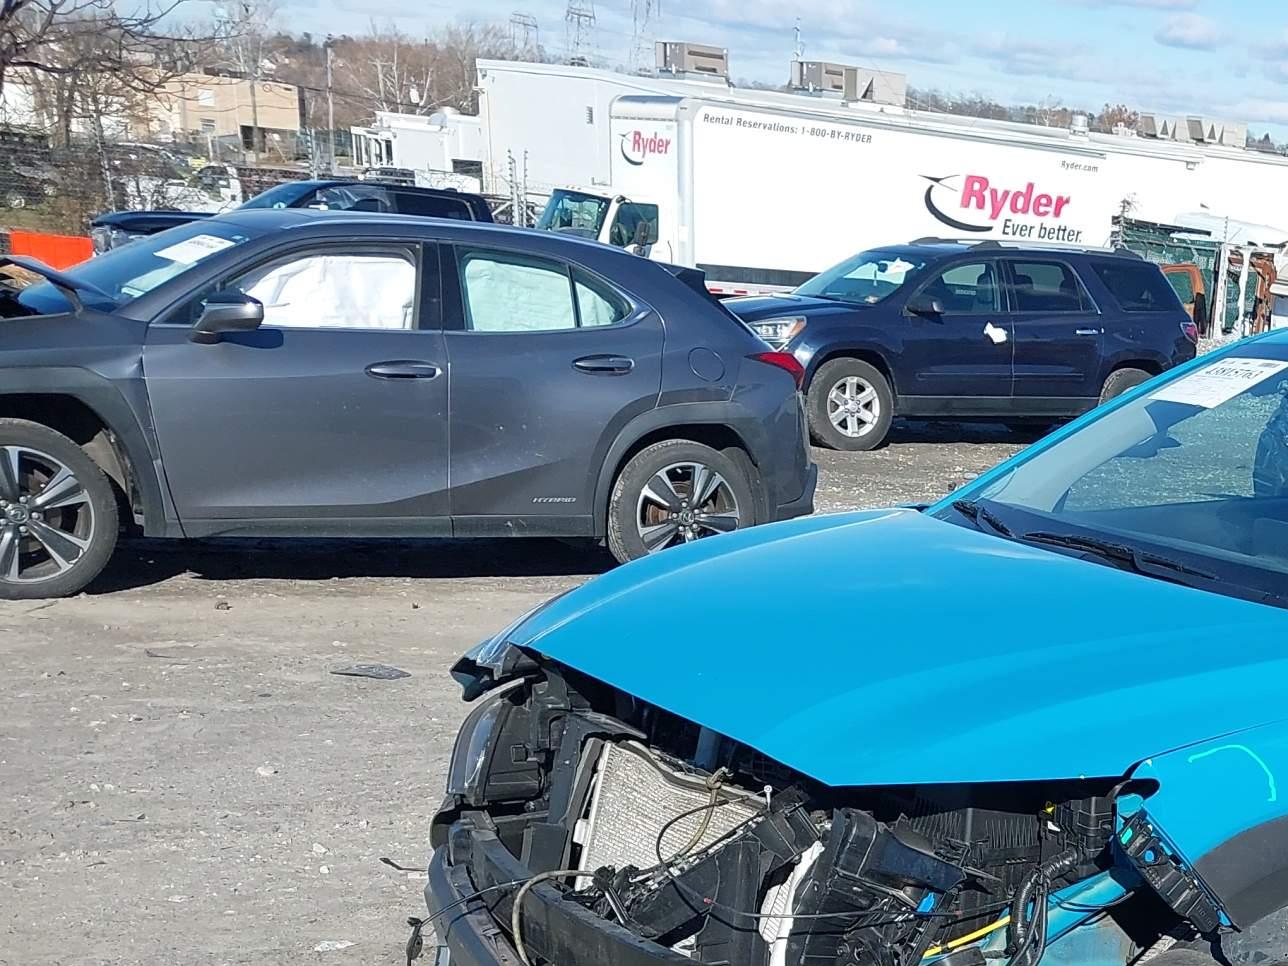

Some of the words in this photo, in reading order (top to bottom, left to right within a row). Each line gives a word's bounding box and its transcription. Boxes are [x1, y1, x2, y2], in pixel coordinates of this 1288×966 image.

[703, 113, 733, 126] Rental
[735, 117, 799, 135] Reservations:
[801, 126, 873, 144] 1-800-BY-RYDER
[632, 130, 671, 158] Ryder
[1060, 160, 1099, 173] Ryder.com
[959, 174, 1071, 220] Ryder
[1002, 219, 1035, 238] Ever
[1038, 222, 1083, 243] better.
